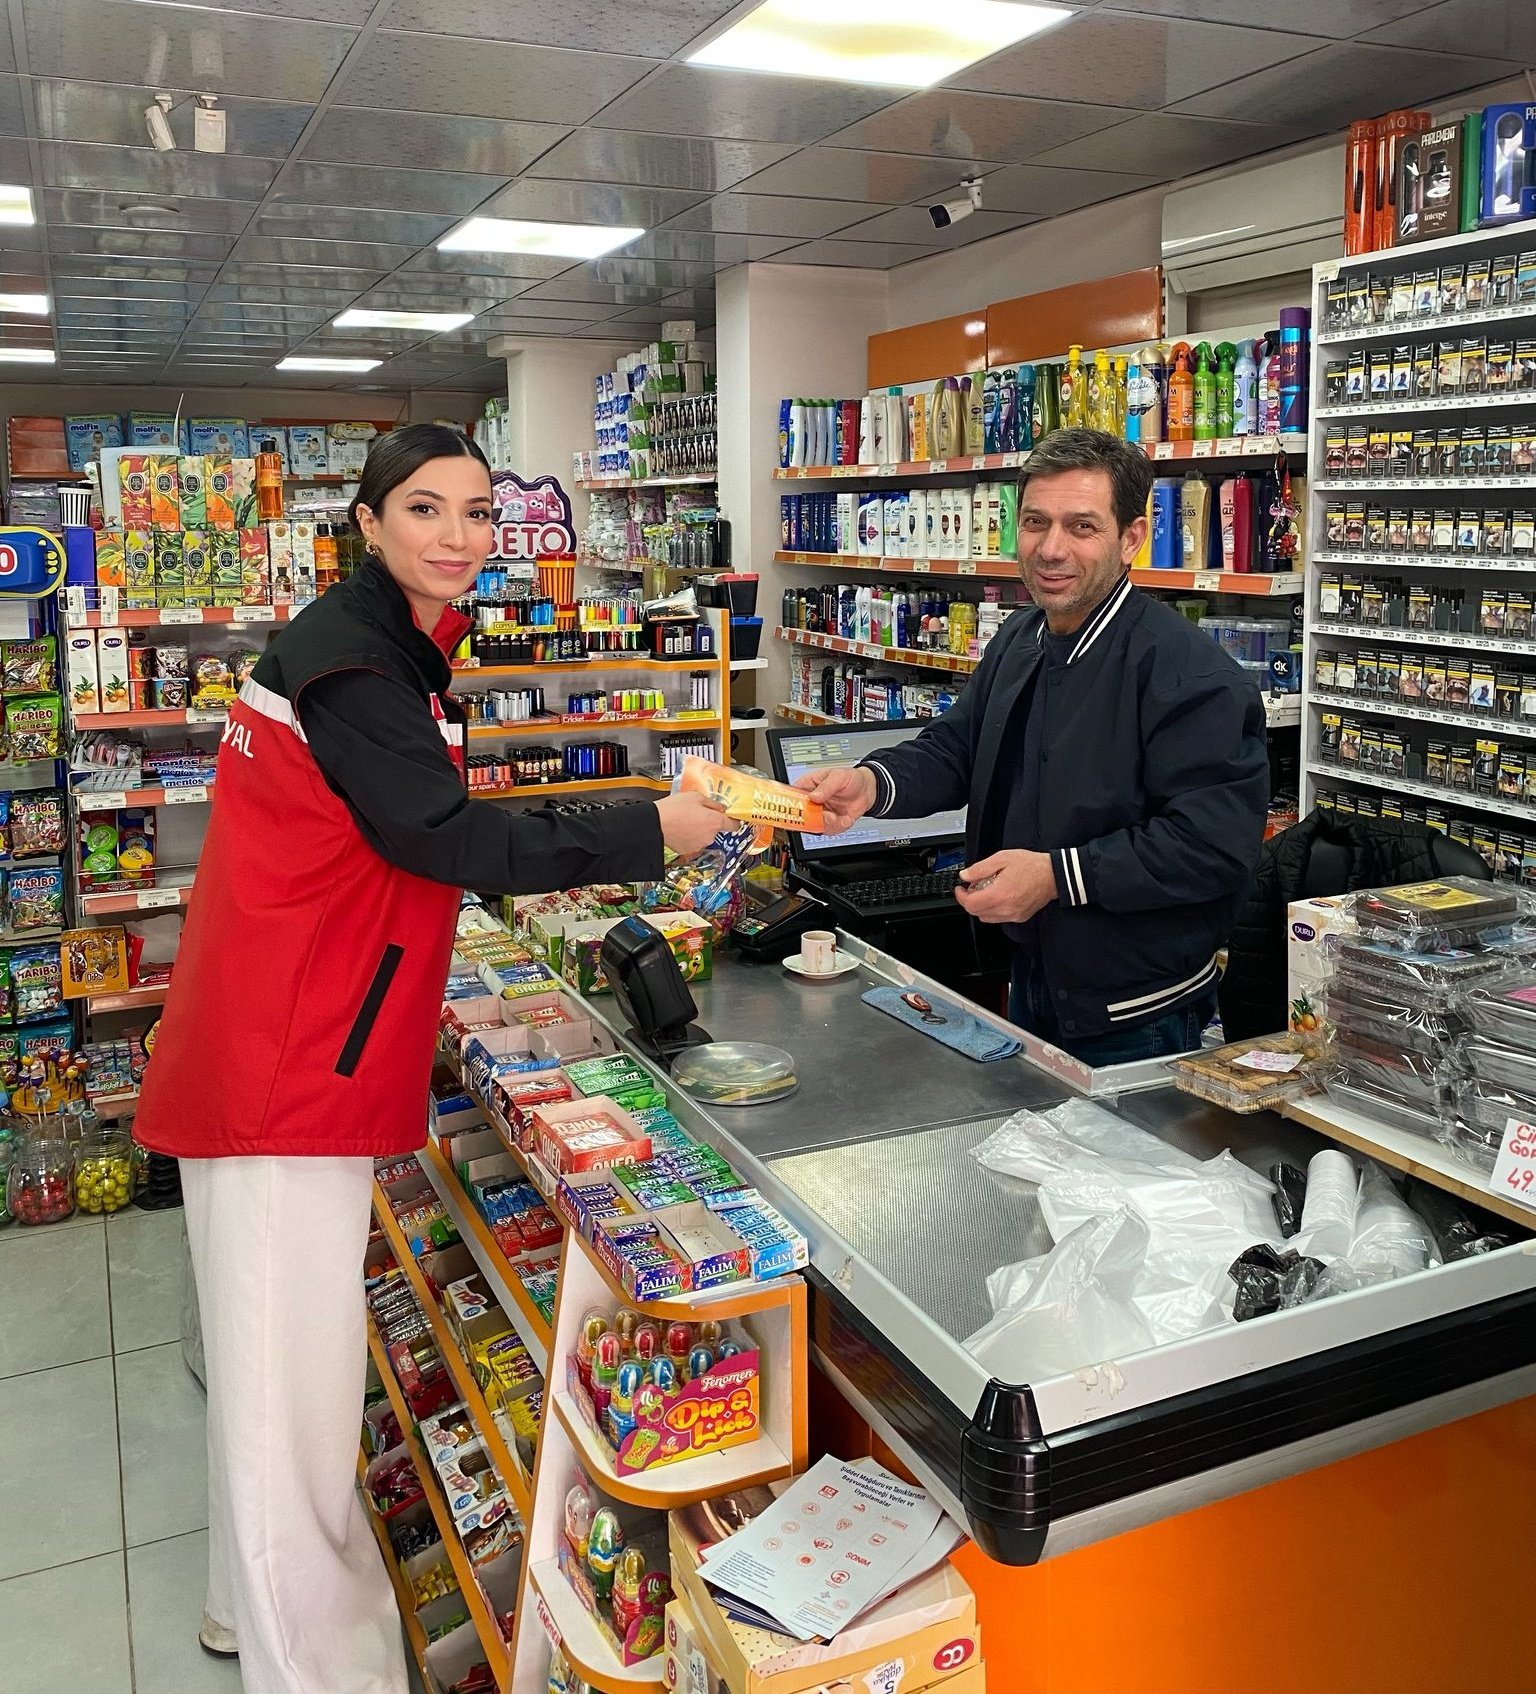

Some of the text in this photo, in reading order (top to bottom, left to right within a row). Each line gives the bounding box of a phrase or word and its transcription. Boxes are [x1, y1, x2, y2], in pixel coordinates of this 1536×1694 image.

[8, 644, 48, 654] HARIBO
[12, 710, 53, 722] HARIBO
[563, 715, 586, 723] Cricket
[616, 712, 639, 721] Cricket
[166, 778, 204, 788] mentos
[14, 802, 57, 816] HARIBO
[15, 876, 57, 889] HARIBO
[1294, 926, 1314, 938] DURU
[25, 1036, 65, 1049] HARIBO
[758, 1252, 792, 1271] FALIM
[698, 1260, 734, 1280] FALIM
[641, 1275, 678, 1292] FALIM
[701, 1370, 754, 1391] Fenomen
[668, 1399, 725, 1430] Dip
[694, 1411, 753, 1447] Lick
